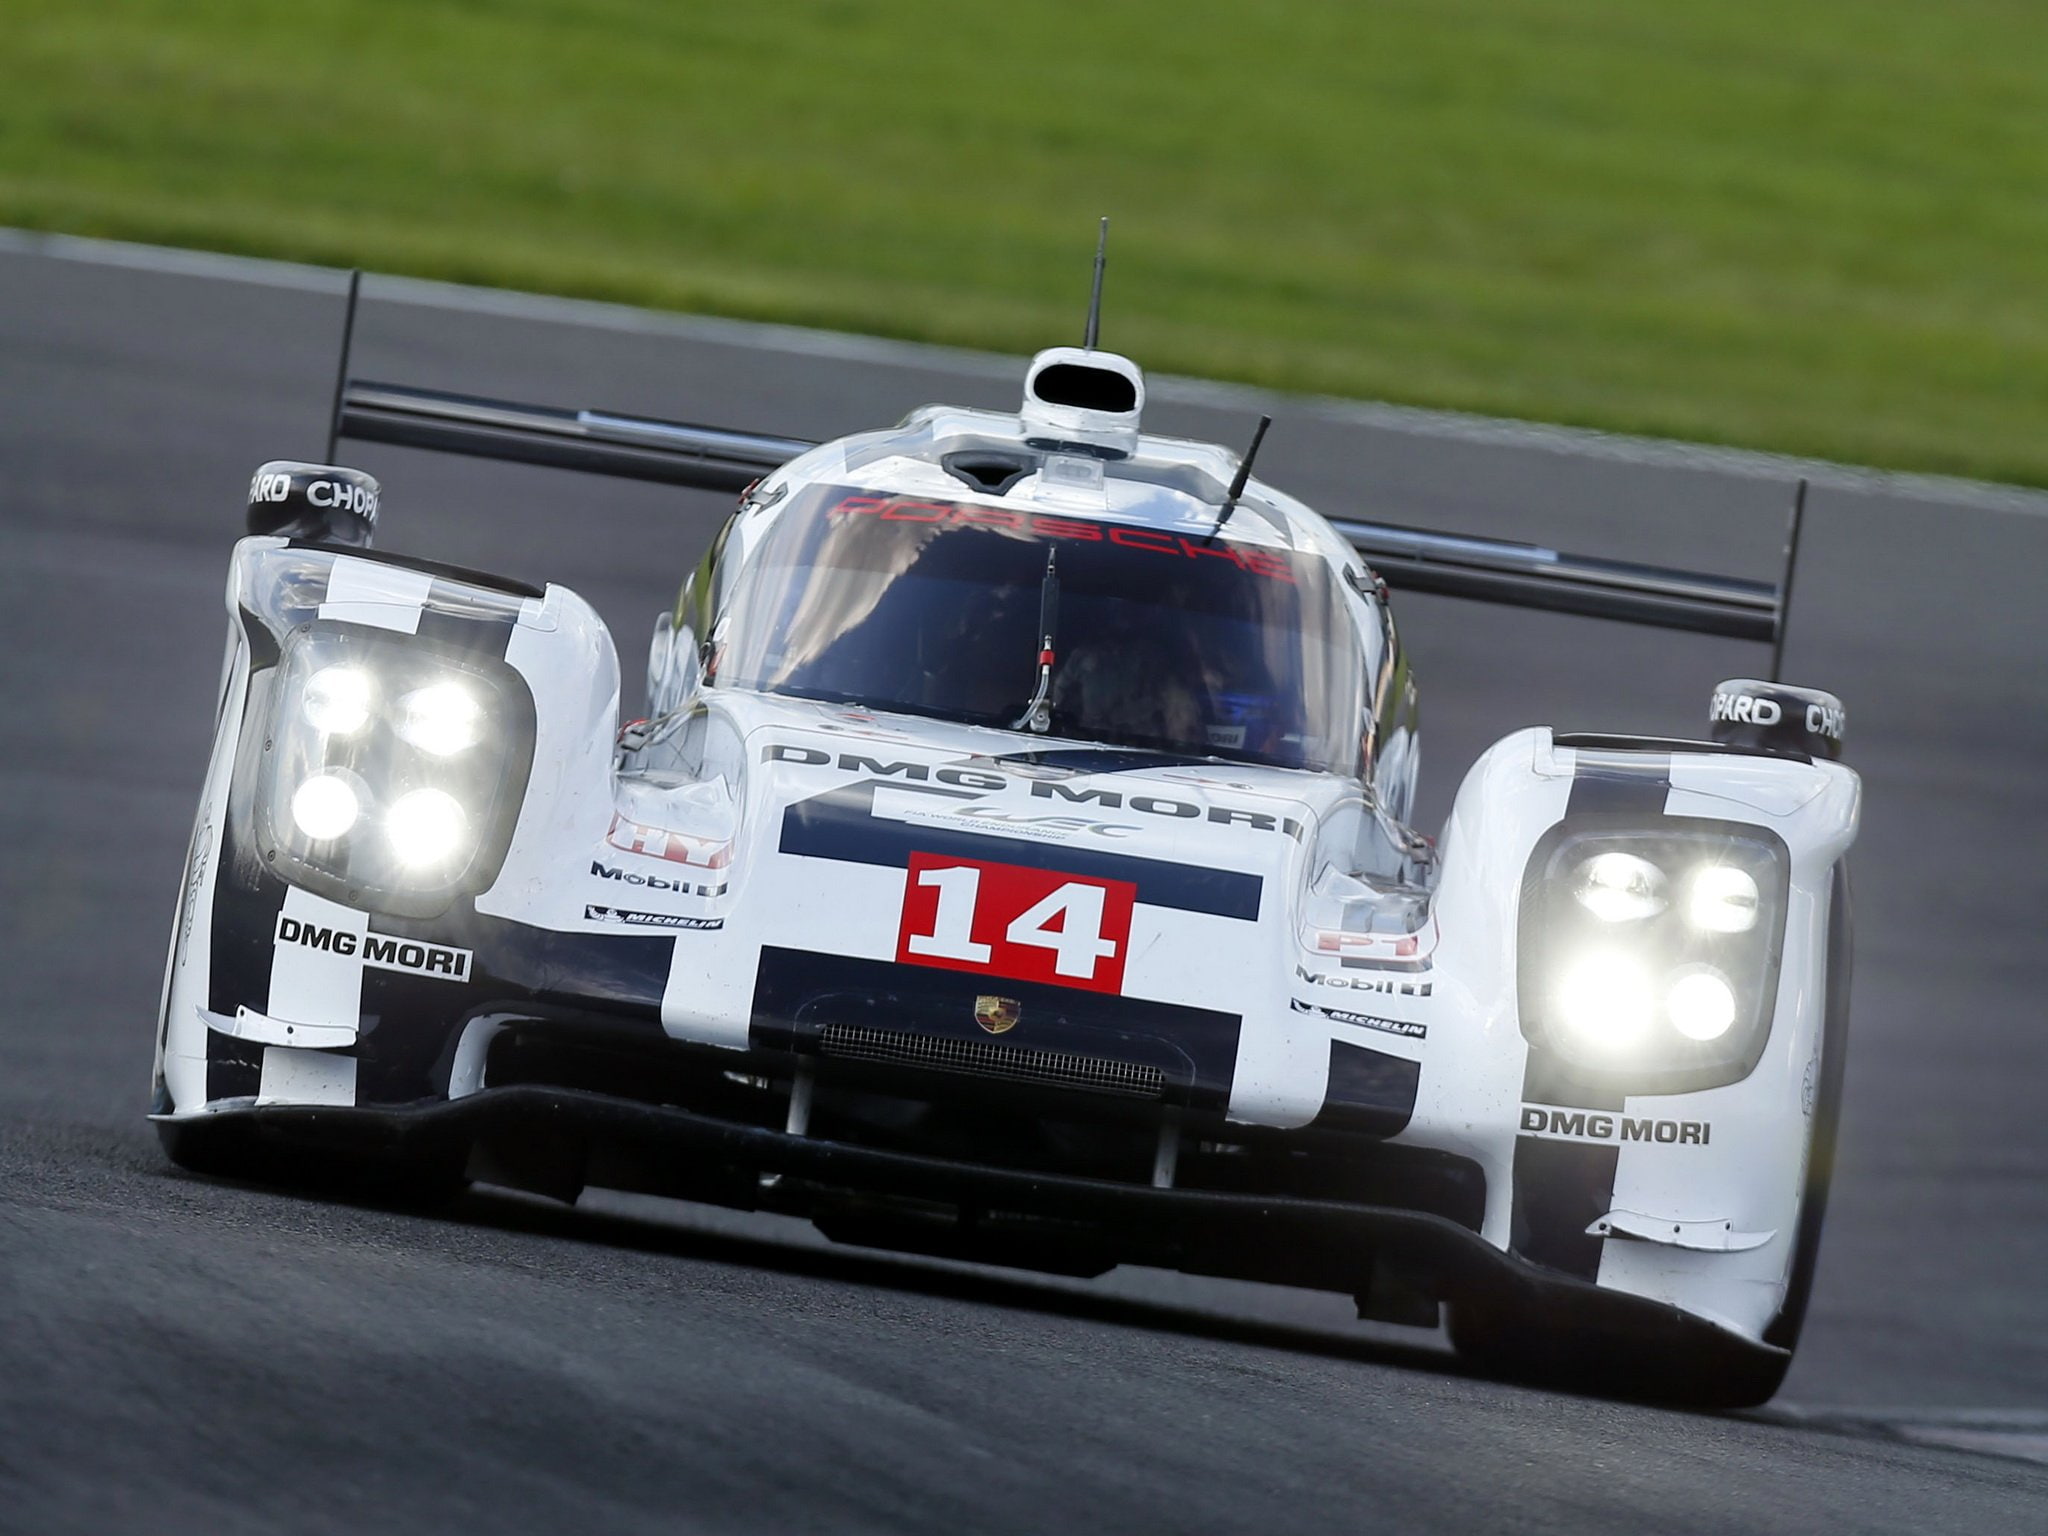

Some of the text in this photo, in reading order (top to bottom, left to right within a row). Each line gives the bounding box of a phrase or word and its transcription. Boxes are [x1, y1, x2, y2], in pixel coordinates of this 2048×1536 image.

[826, 496, 1297, 584] PORSCHE
[761, 744, 1304, 845] DMG MORI
[590, 860, 691, 894] Mobil
[625, 912, 722, 929] MICHELIN
[908, 865, 1117, 980] 14
[279, 917, 467, 976] DMG MORI
[1295, 963, 1394, 995] Mobil
[1329, 1011, 1425, 1035] MICHELIN
[1520, 1107, 1711, 1145] DMG MORI
